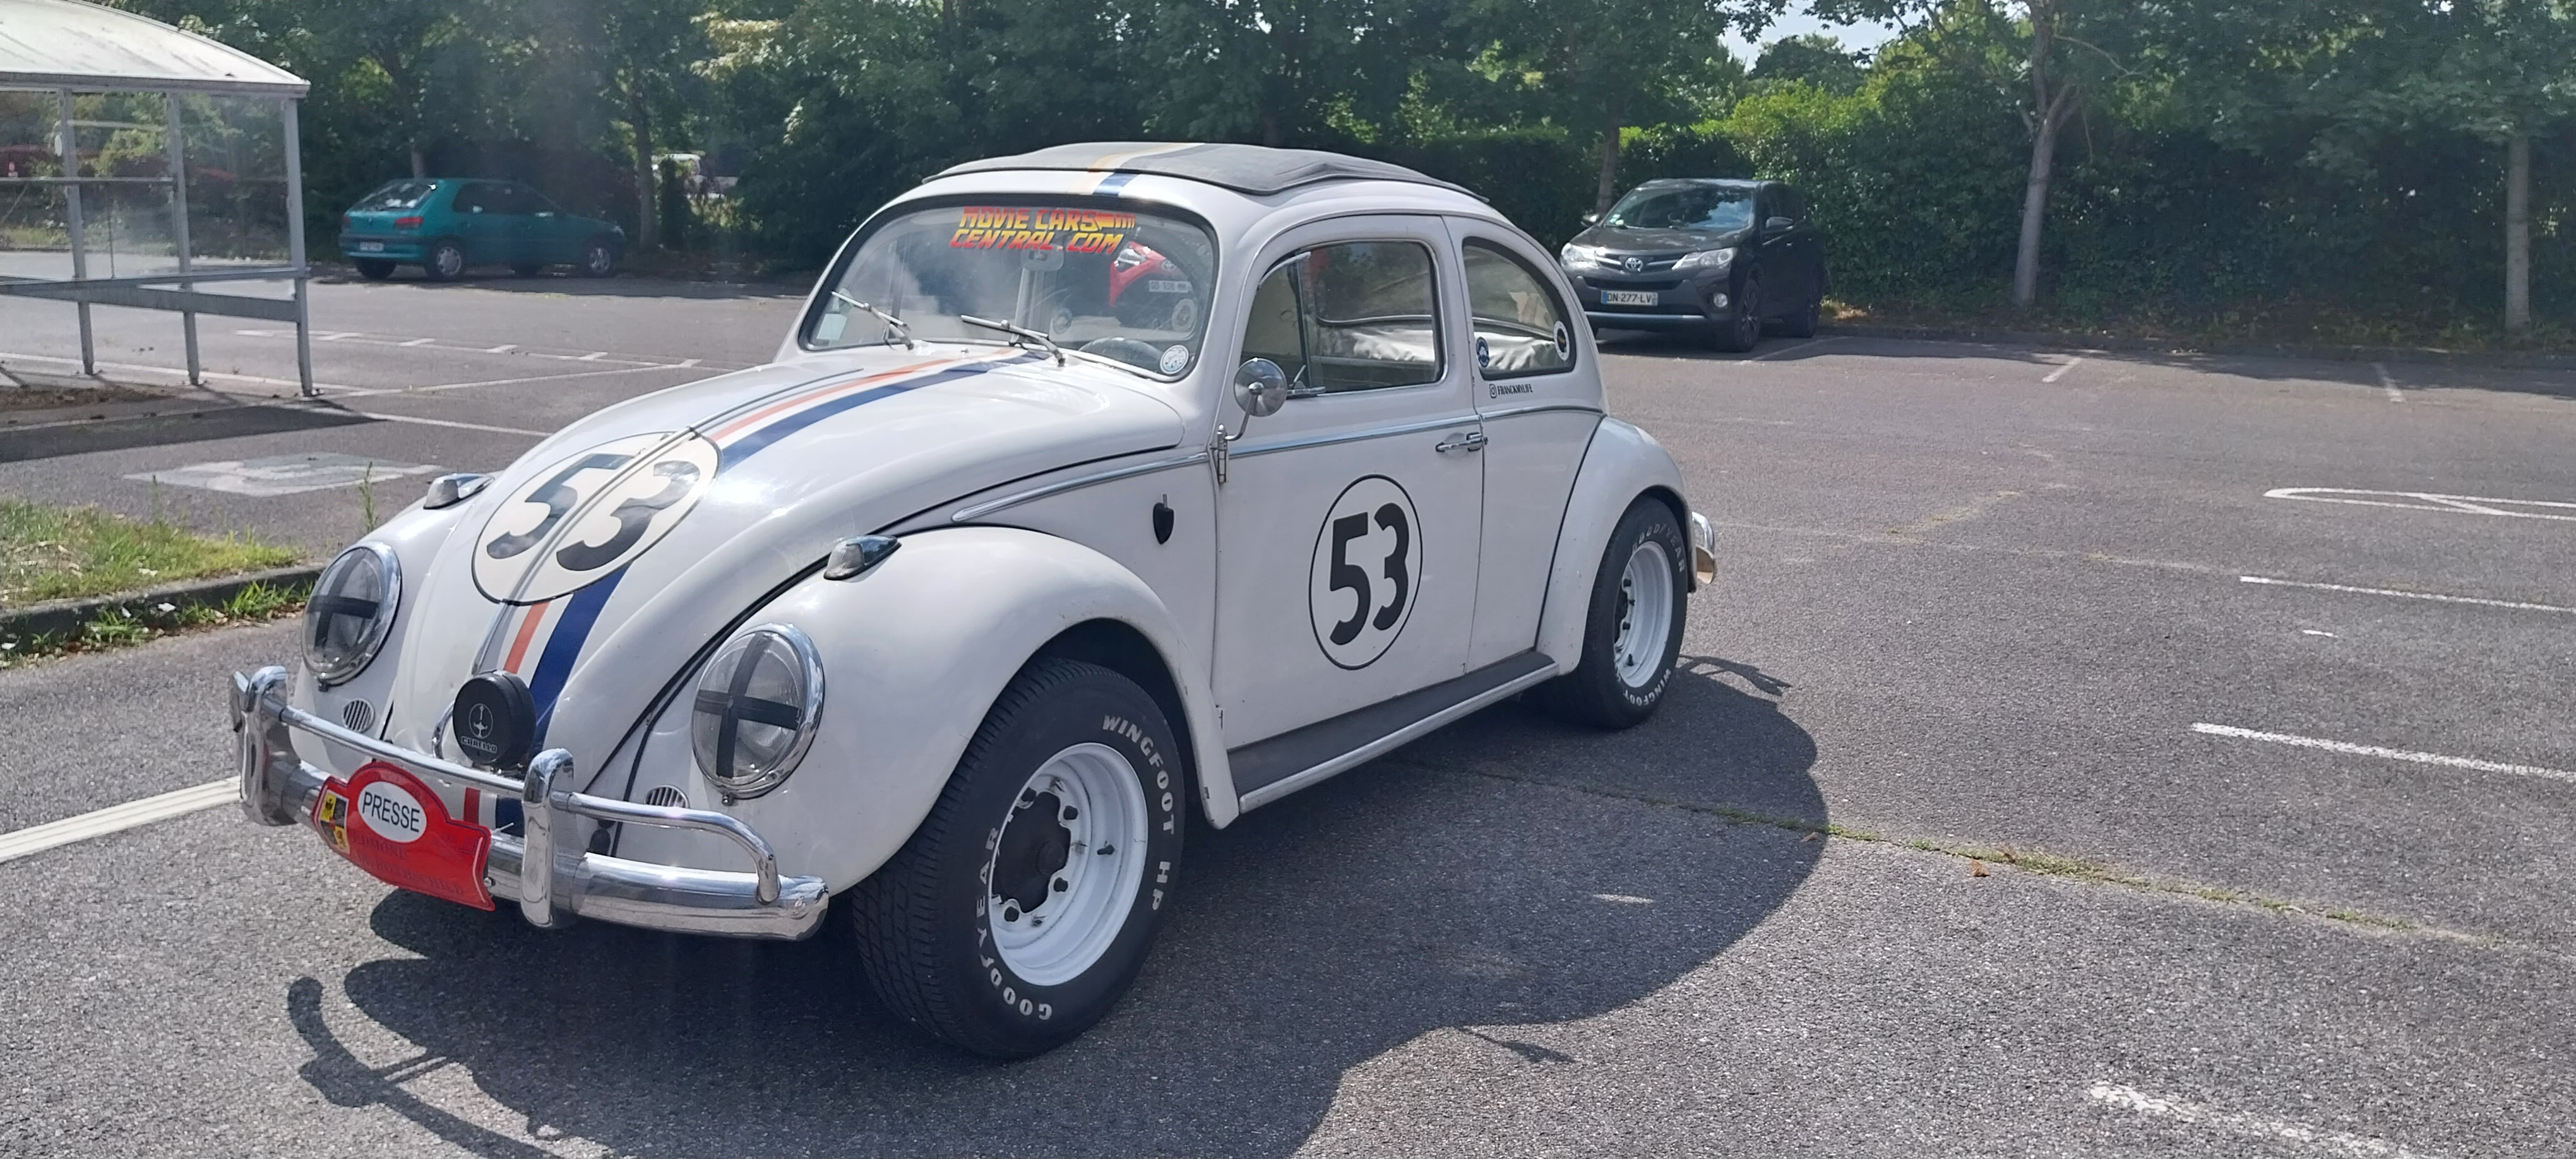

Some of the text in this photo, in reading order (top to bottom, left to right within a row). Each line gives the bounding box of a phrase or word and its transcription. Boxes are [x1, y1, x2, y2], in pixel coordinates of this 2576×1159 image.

[960, 206, 1102, 232] MOVIE CARS
[486, 453, 701, 571] 53
[1329, 502, 1410, 646] 53
[362, 791, 420, 833] PRESSE
[1102, 715, 1174, 911] WINGFOOT HP
[976, 828, 1052, 1020] GOODYEAR
